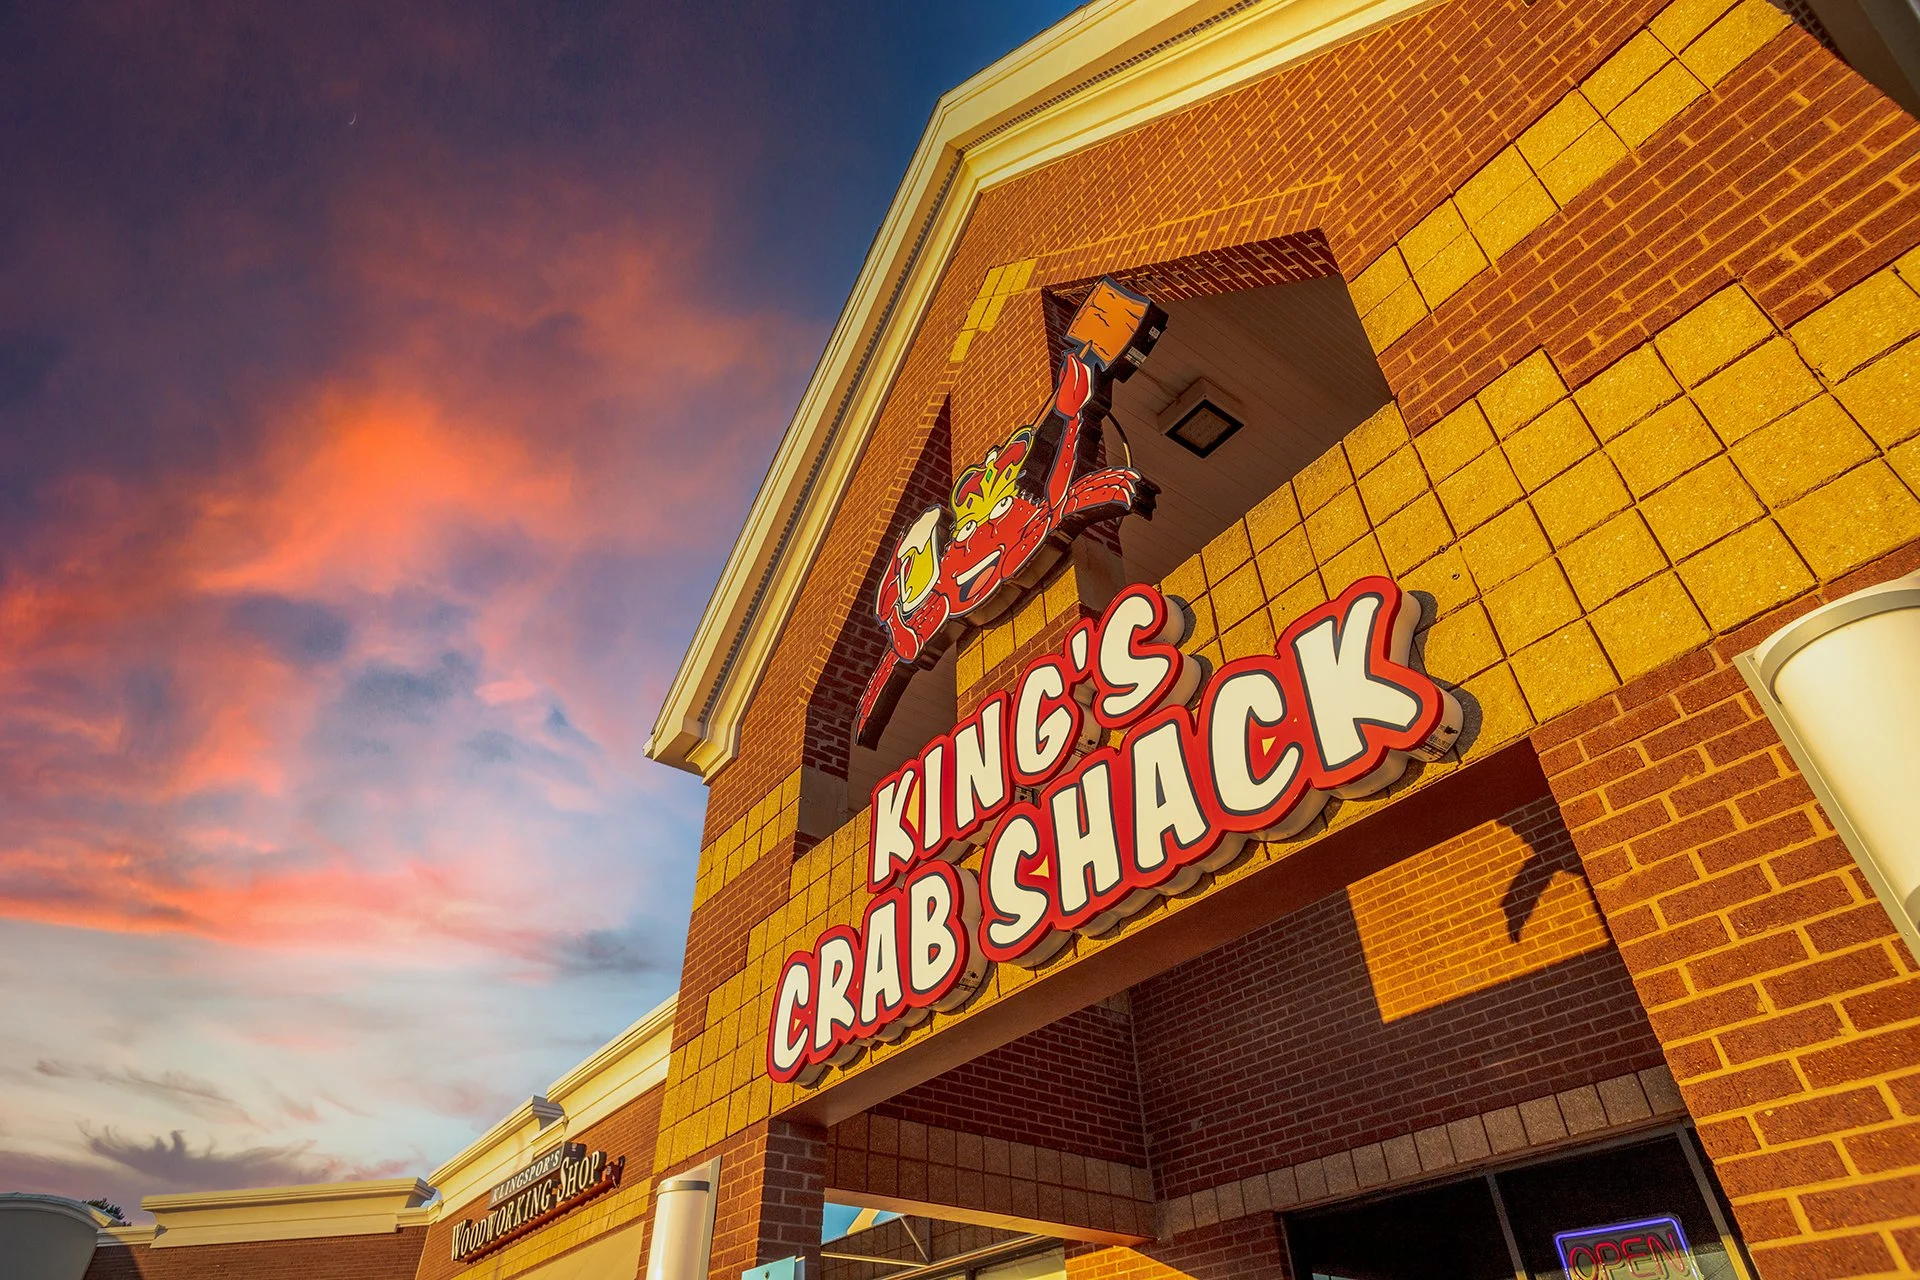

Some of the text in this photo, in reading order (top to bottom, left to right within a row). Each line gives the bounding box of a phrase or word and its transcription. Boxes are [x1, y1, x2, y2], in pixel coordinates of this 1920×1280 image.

[870, 590, 1174, 887] KING'S
[771, 588, 1421, 1075] CRAB SHACK
[451, 1149, 601, 1261] WOODWORKING SHOP
[491, 1149, 561, 1203] KLINGSPOR'S
[1568, 1232, 1685, 1280] OPEN
